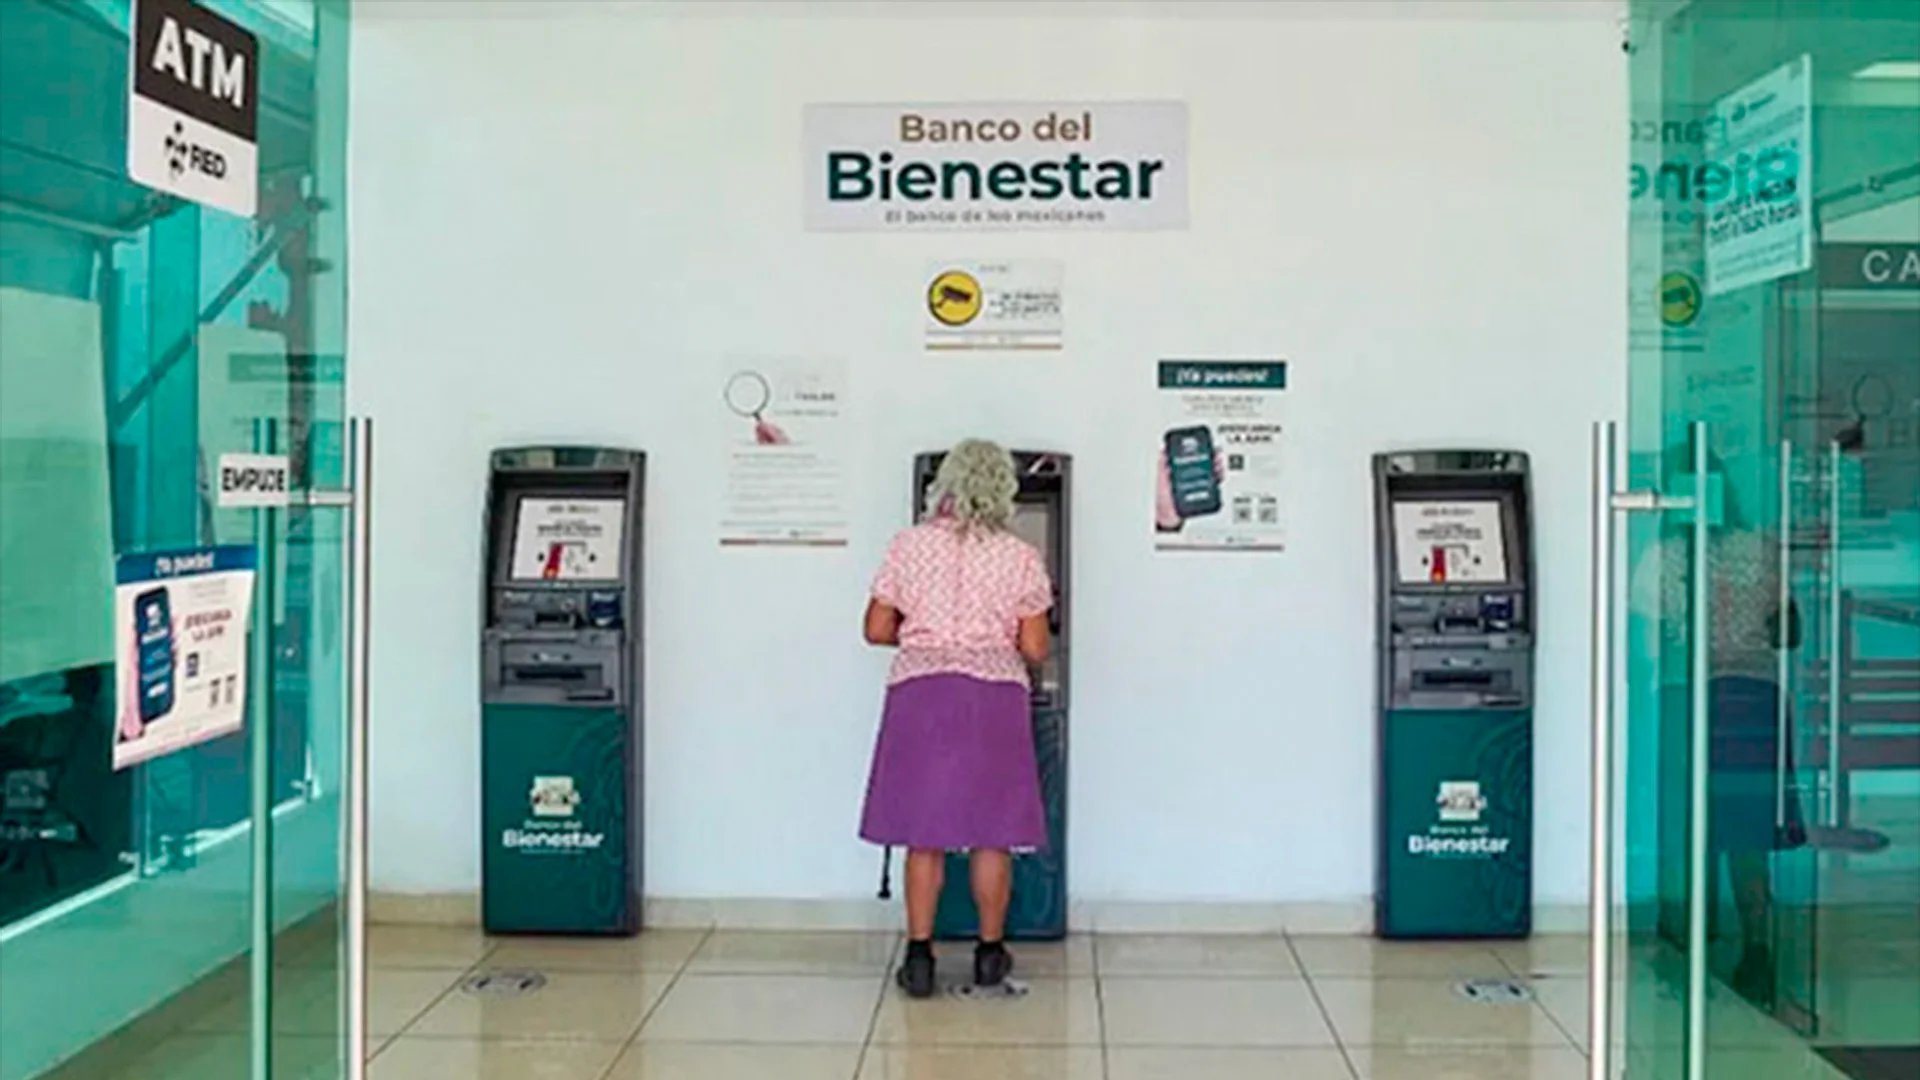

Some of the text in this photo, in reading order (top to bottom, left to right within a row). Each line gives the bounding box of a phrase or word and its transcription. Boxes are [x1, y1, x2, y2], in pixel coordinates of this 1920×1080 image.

[152, 16, 245, 108] ATM
[899, 111, 1093, 143] Banco del
[190, 143, 227, 179] RED
[827, 150, 1164, 202] Bienestar
[222, 466, 285, 492] EMPUJE
[502, 828, 605, 848] Bienestar
[1407, 834, 1510, 855] Bienestar
